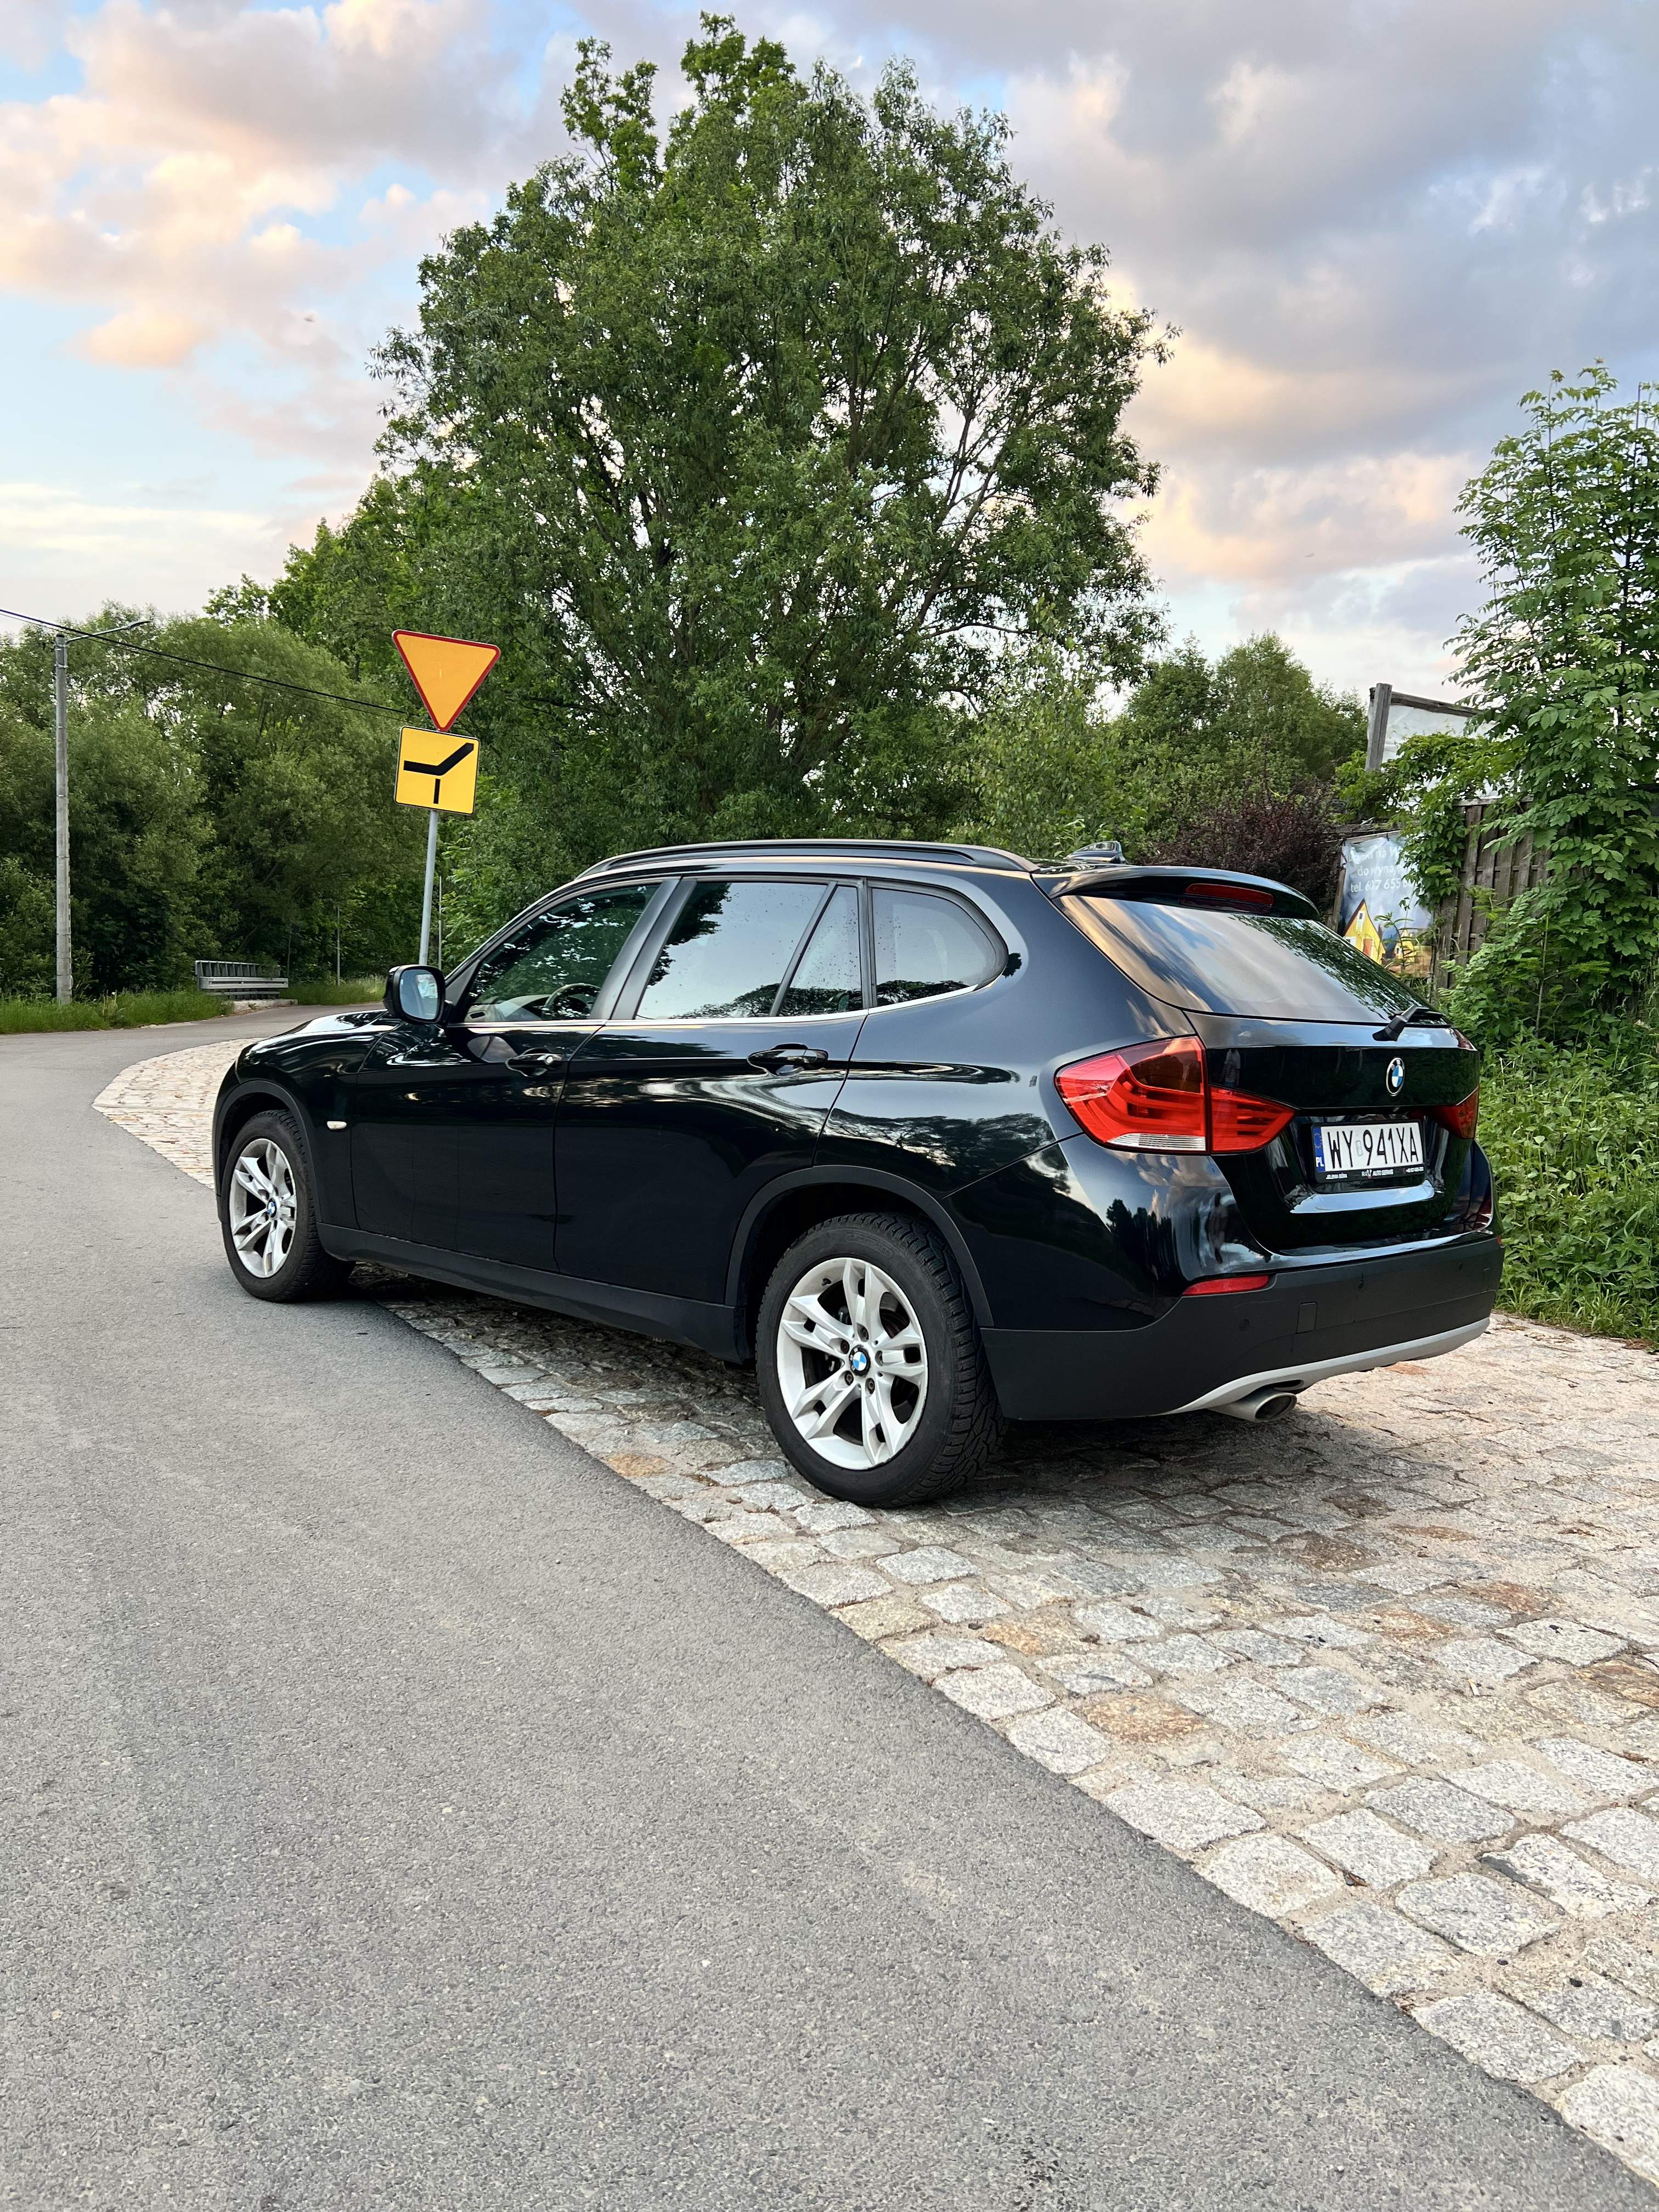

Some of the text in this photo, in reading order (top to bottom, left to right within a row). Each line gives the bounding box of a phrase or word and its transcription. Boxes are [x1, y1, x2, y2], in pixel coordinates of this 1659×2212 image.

[1376, 850, 1387, 858] na
[1357, 866, 1369, 876] do
[1351, 882, 1363, 893] tel.
[1384, 878, 1401, 889] 655
[1328, 1127, 1418, 1169] WY 941XA
[1316, 1156, 1324, 1167] PL
